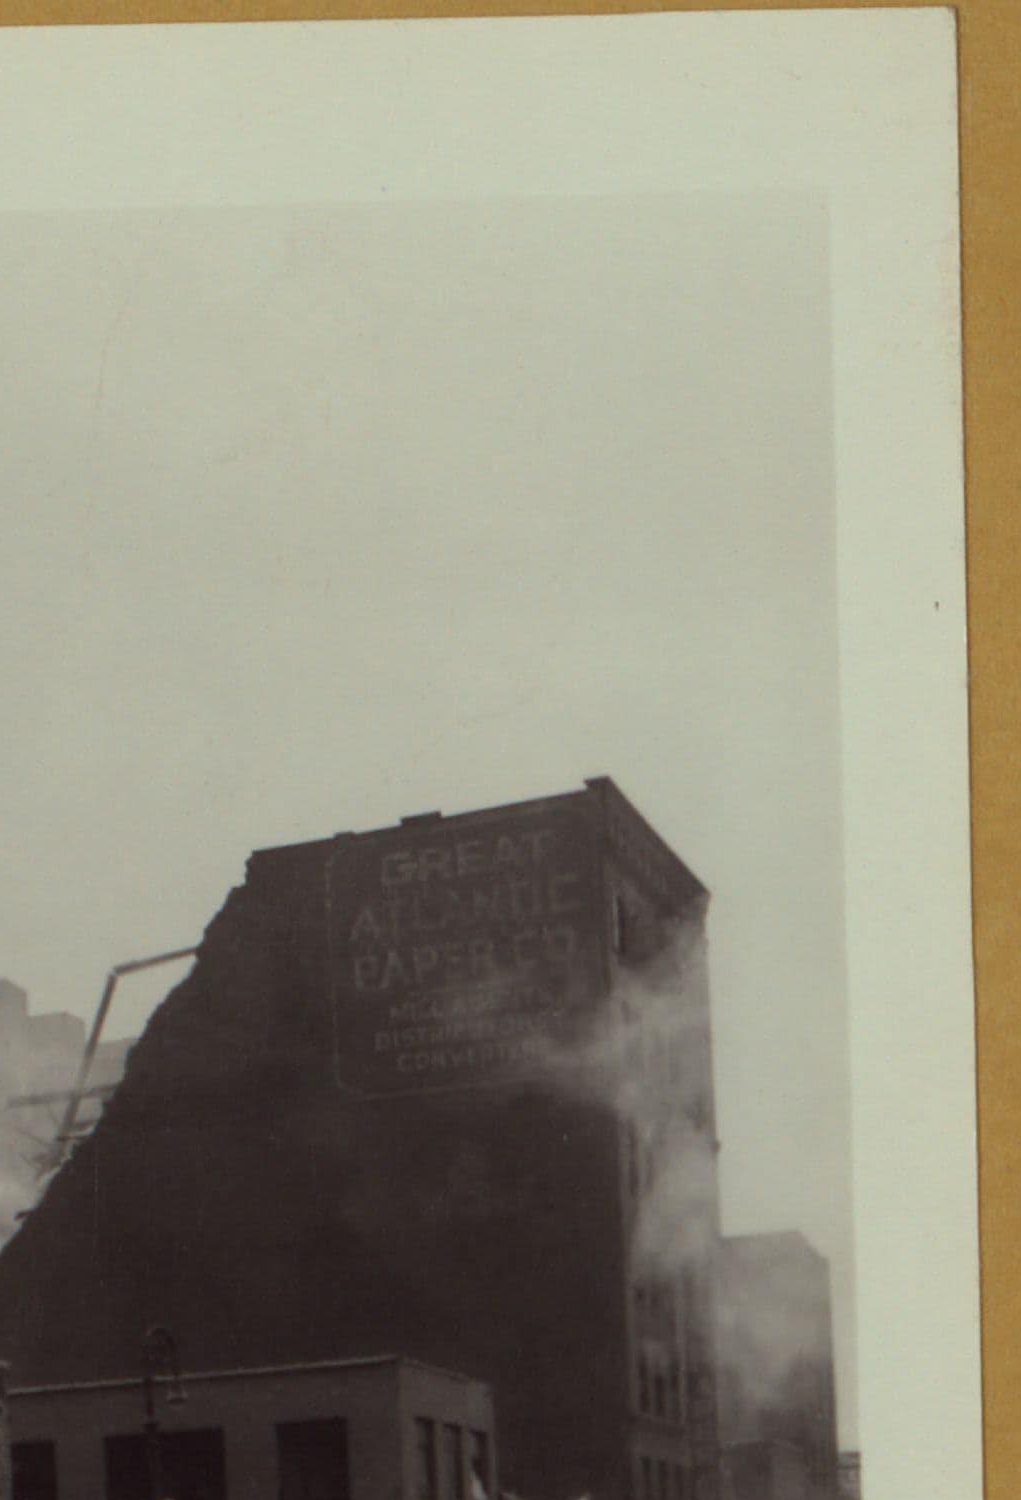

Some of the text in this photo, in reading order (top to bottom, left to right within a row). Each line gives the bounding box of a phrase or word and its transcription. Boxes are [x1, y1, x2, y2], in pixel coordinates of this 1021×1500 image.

[381, 828, 553, 886] GREAT
[349, 873, 583, 945] ATLANTIC
[353, 937, 496, 990] PAPER
